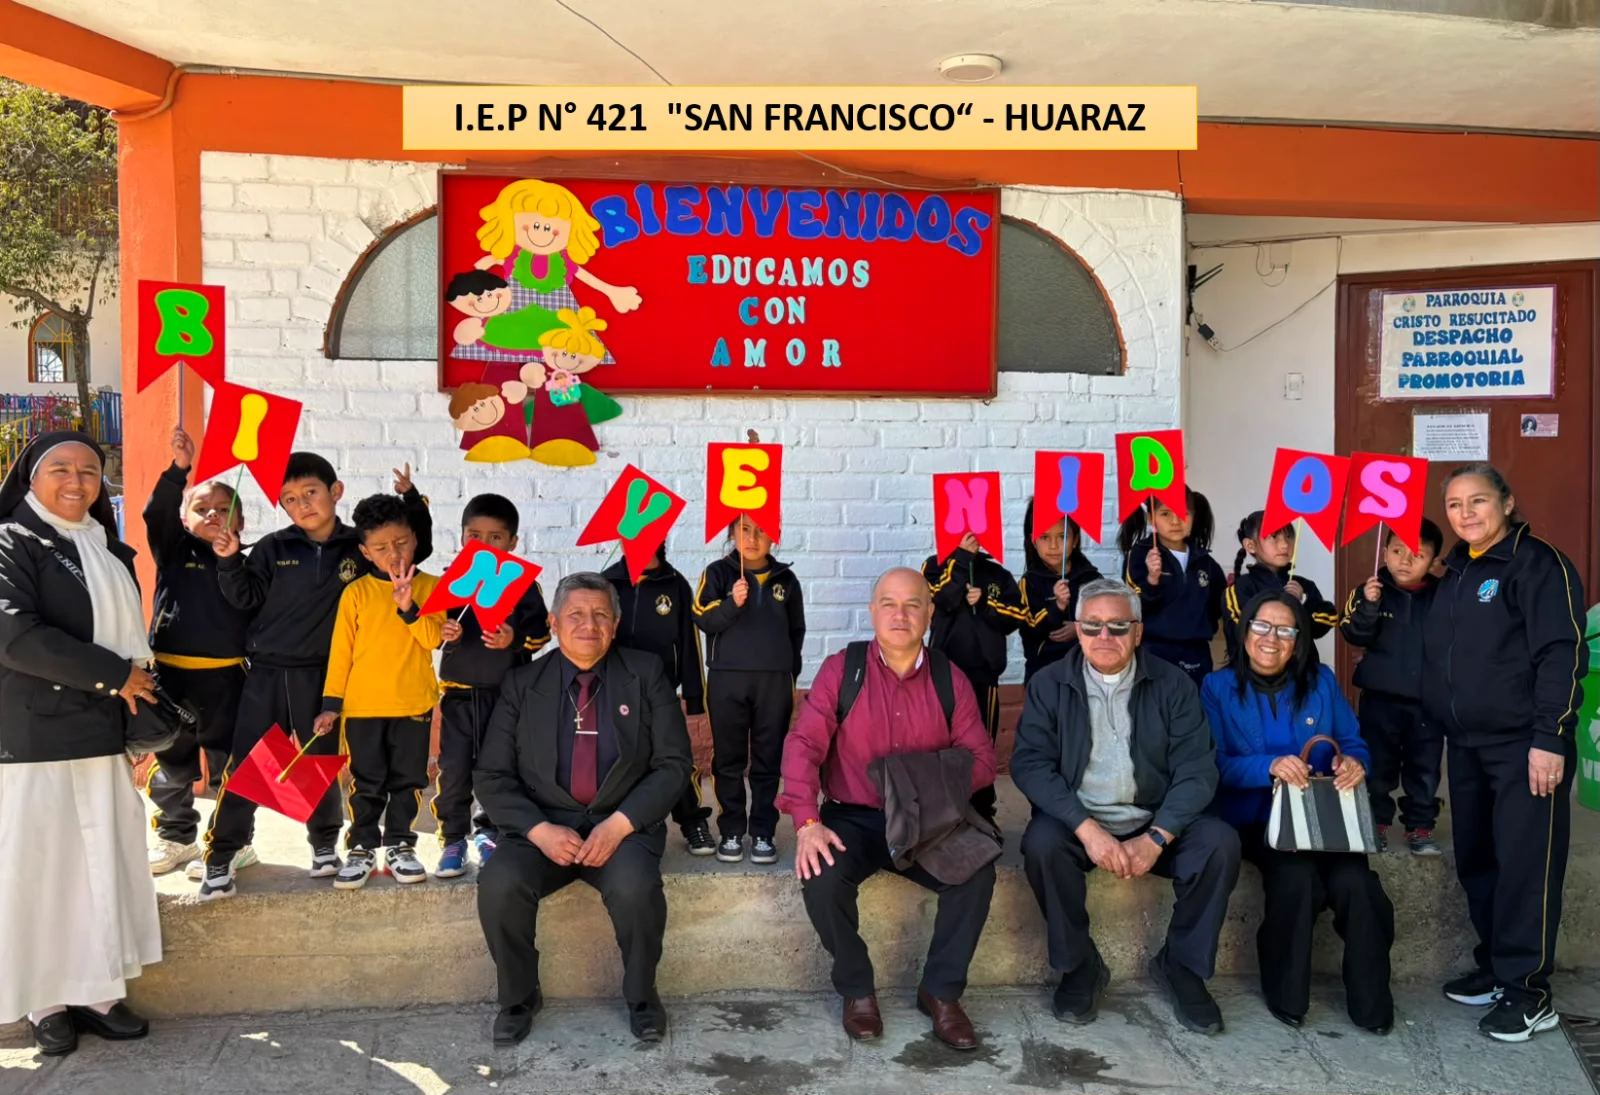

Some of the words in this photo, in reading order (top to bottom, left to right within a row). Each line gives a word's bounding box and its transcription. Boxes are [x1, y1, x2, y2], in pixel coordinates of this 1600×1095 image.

[590, 182, 992, 258] BIENVENIDOS
[686, 253, 870, 289] EDUCAMOS
[738, 296, 807, 327] CON
[1426, 292, 1507, 307] PARROQUIA
[155, 288, 214, 357] B
[1393, 314, 1441, 329] CRISTO
[1449, 309, 1537, 326] RESUCITADO
[1413, 328, 1513, 346] DESPACHO
[1402, 348, 1524, 367] PARROQUIAL
[1398, 370, 1526, 389] PROMOTORIA
[720, 448, 770, 510] E
[1130, 436, 1175, 491] D
[1281, 455, 1333, 515] O
[1359, 460, 1412, 519] S
